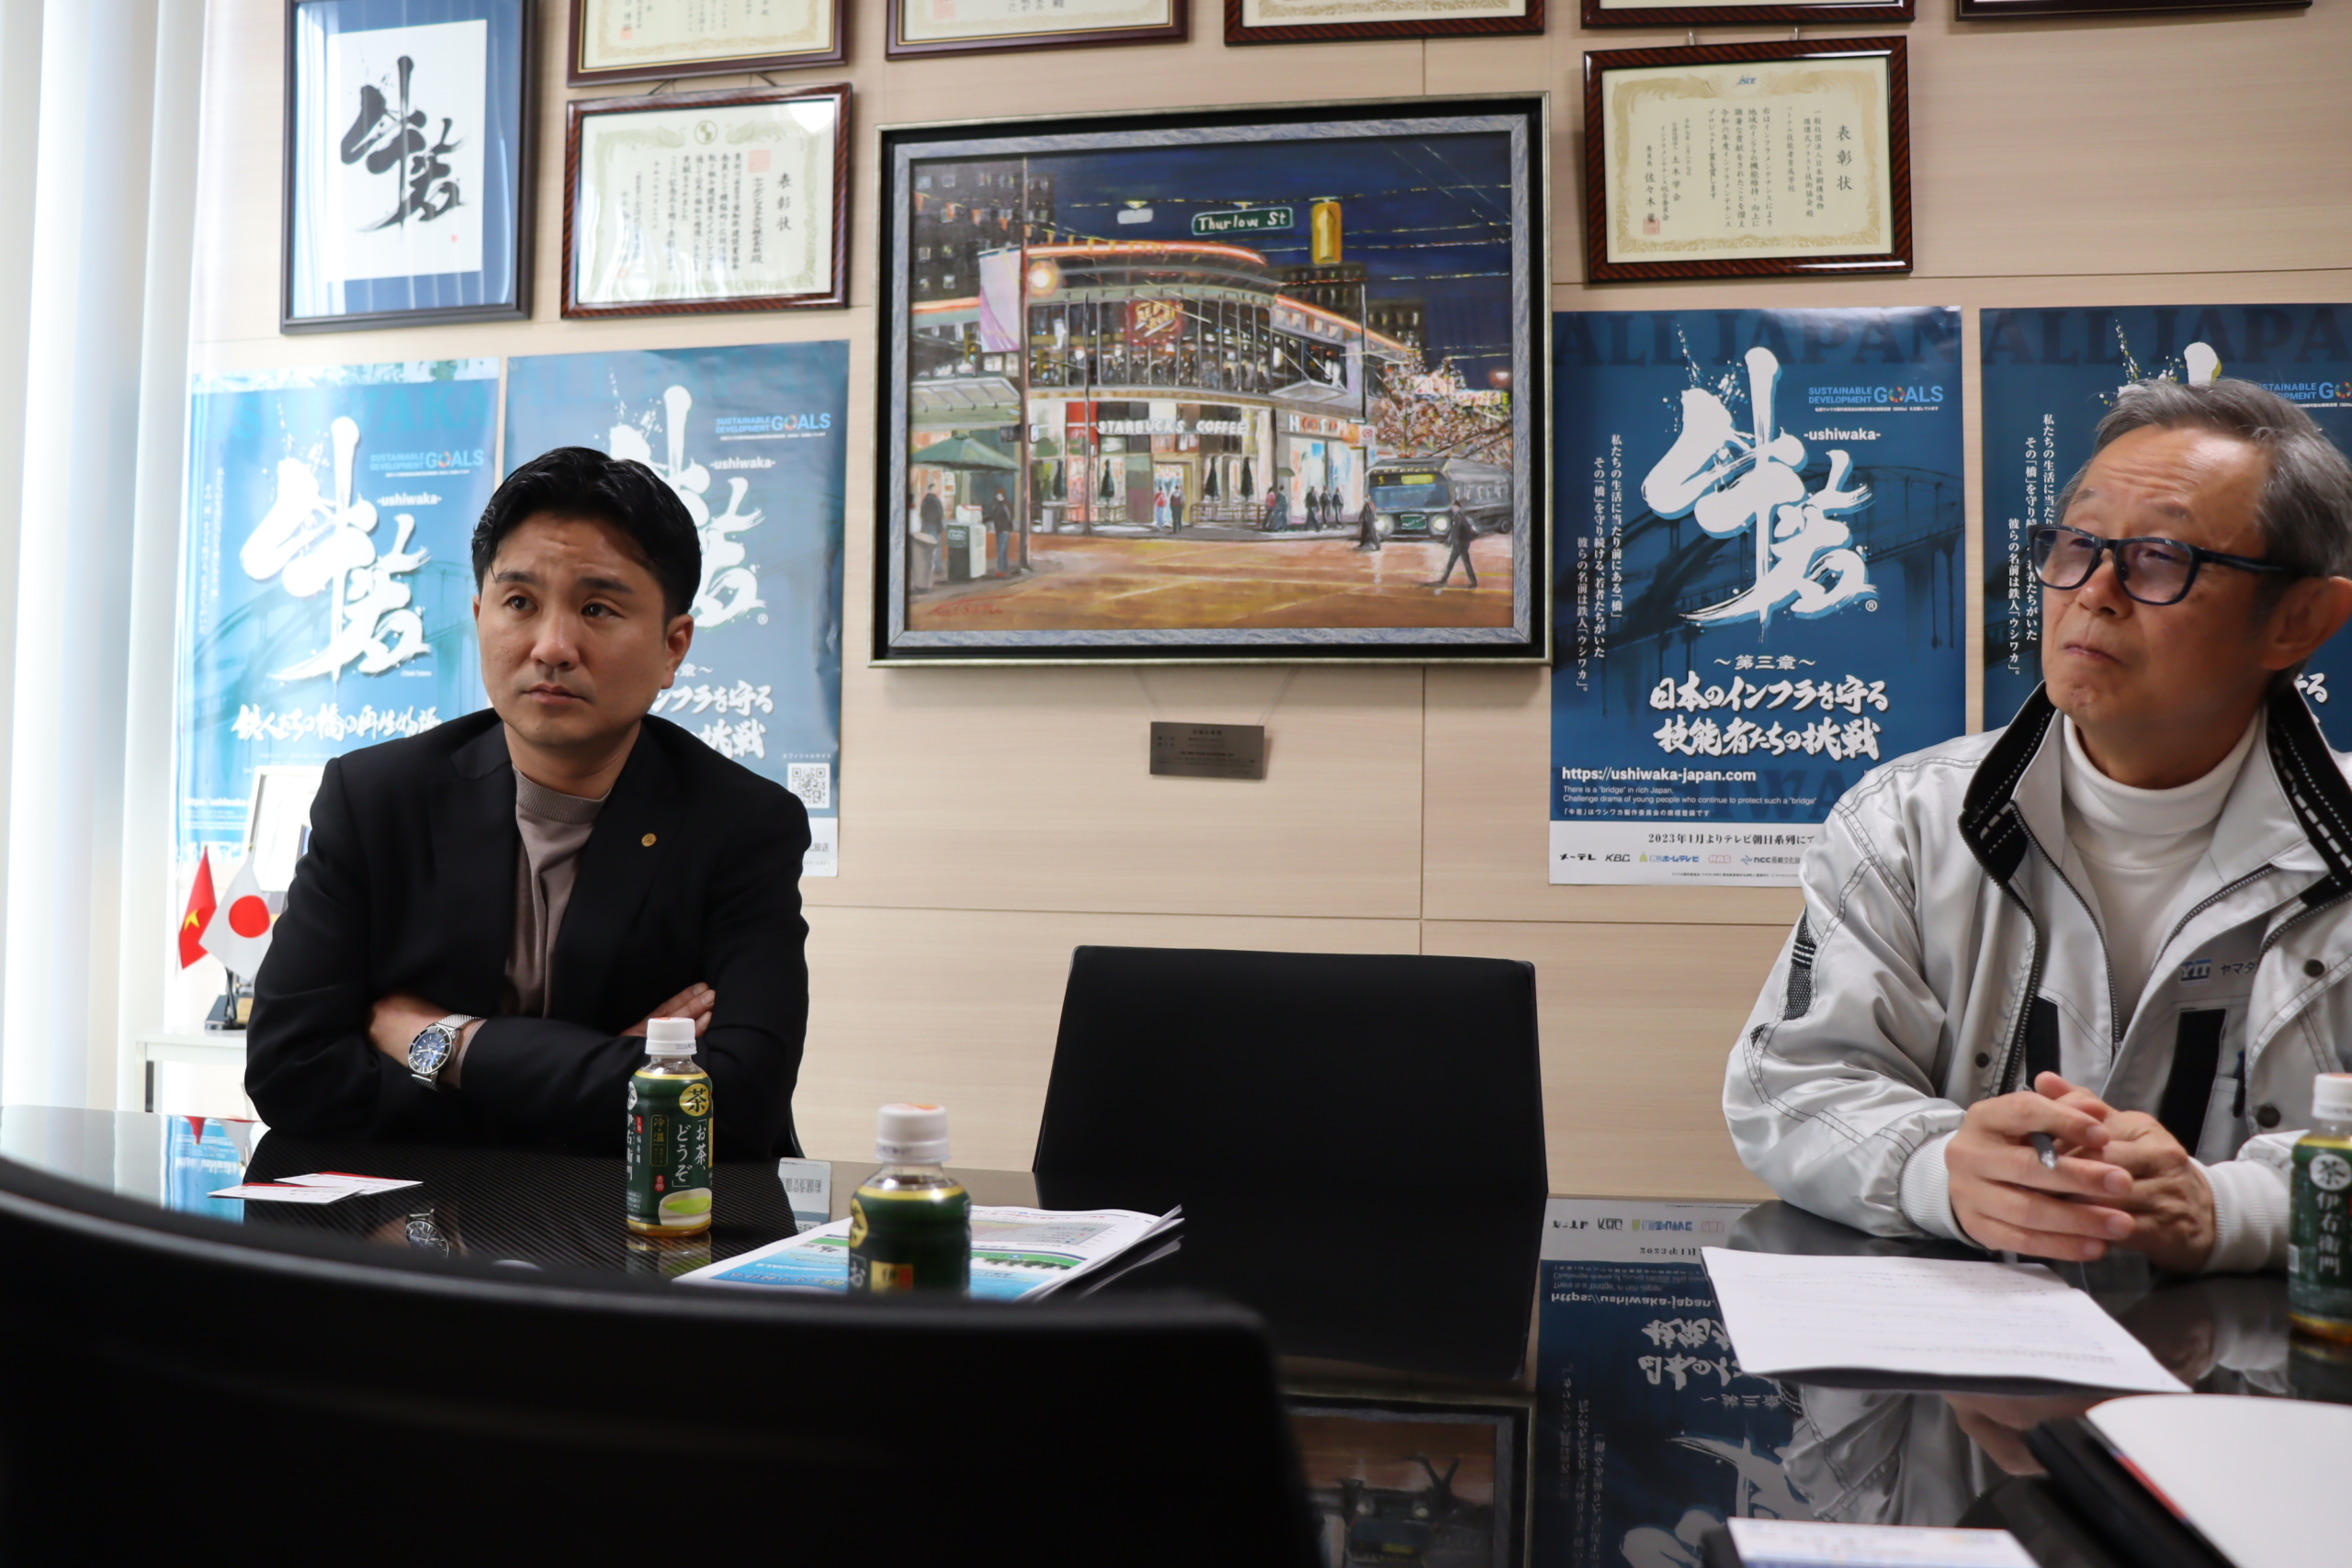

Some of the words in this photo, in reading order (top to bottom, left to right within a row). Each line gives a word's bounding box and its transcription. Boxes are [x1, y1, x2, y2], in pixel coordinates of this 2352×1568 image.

[1837, 125, 1852, 191] 表彰状
[776, 172, 794, 232] 表彰状
[1197, 214, 1259, 231] Thurlow
[1266, 211, 1287, 226] St
[1808, 387, 1872, 395] SUSTAINABLE
[1808, 396, 1872, 404] DEVELOPMENT
[1873, 385, 1944, 403] GOALS
[2258, 382, 2317, 391] STAINABLE
[771, 413, 831, 432] GOALS
[1097, 420, 1184, 434] STARBUCKS
[1195, 420, 1247, 434] COFFEE
[1804, 427, 1882, 441] -ushiwaka-
[425, 449, 485, 469] GOALS
[1611, 434, 1623, 619] 私たちの生活に当たり前にある「橋」
[1593, 457, 1606, 659] その「橋」を守り続ける、若者たちがいた
[2007, 517, 2020, 676] 彼らの名前は鉄人「ウシワカ」。
[1577, 536, 1589, 692] 彼らの名前は鉄人「ウシワカ」。
[1649, 671, 1890, 714] 日本のインフラを守る
[1653, 714, 1882, 761] 技能者たちの挑戦
[1562, 766, 1757, 784] https://ushiwaka-japan.com
[1564, 785, 1583, 795] There
[1585, 785, 1590, 795] is
[1635, 785, 1648, 795] rich
[1564, 795, 1598, 805] Challenge
[1600, 795, 1623, 804] drama
[1623, 795, 1630, 804] of
[1631, 796, 1654, 806] young
[1656, 796, 1680, 806] people
[1681, 795, 1696, 804] who
[1698, 795, 1727, 805] continue
[1729, 796, 1736, 805] to
[1737, 796, 1762, 806] protect
[1764, 796, 1781, 805] such
[1605, 853, 1631, 863] KBC
[686, 1088, 707, 1113] 茶
